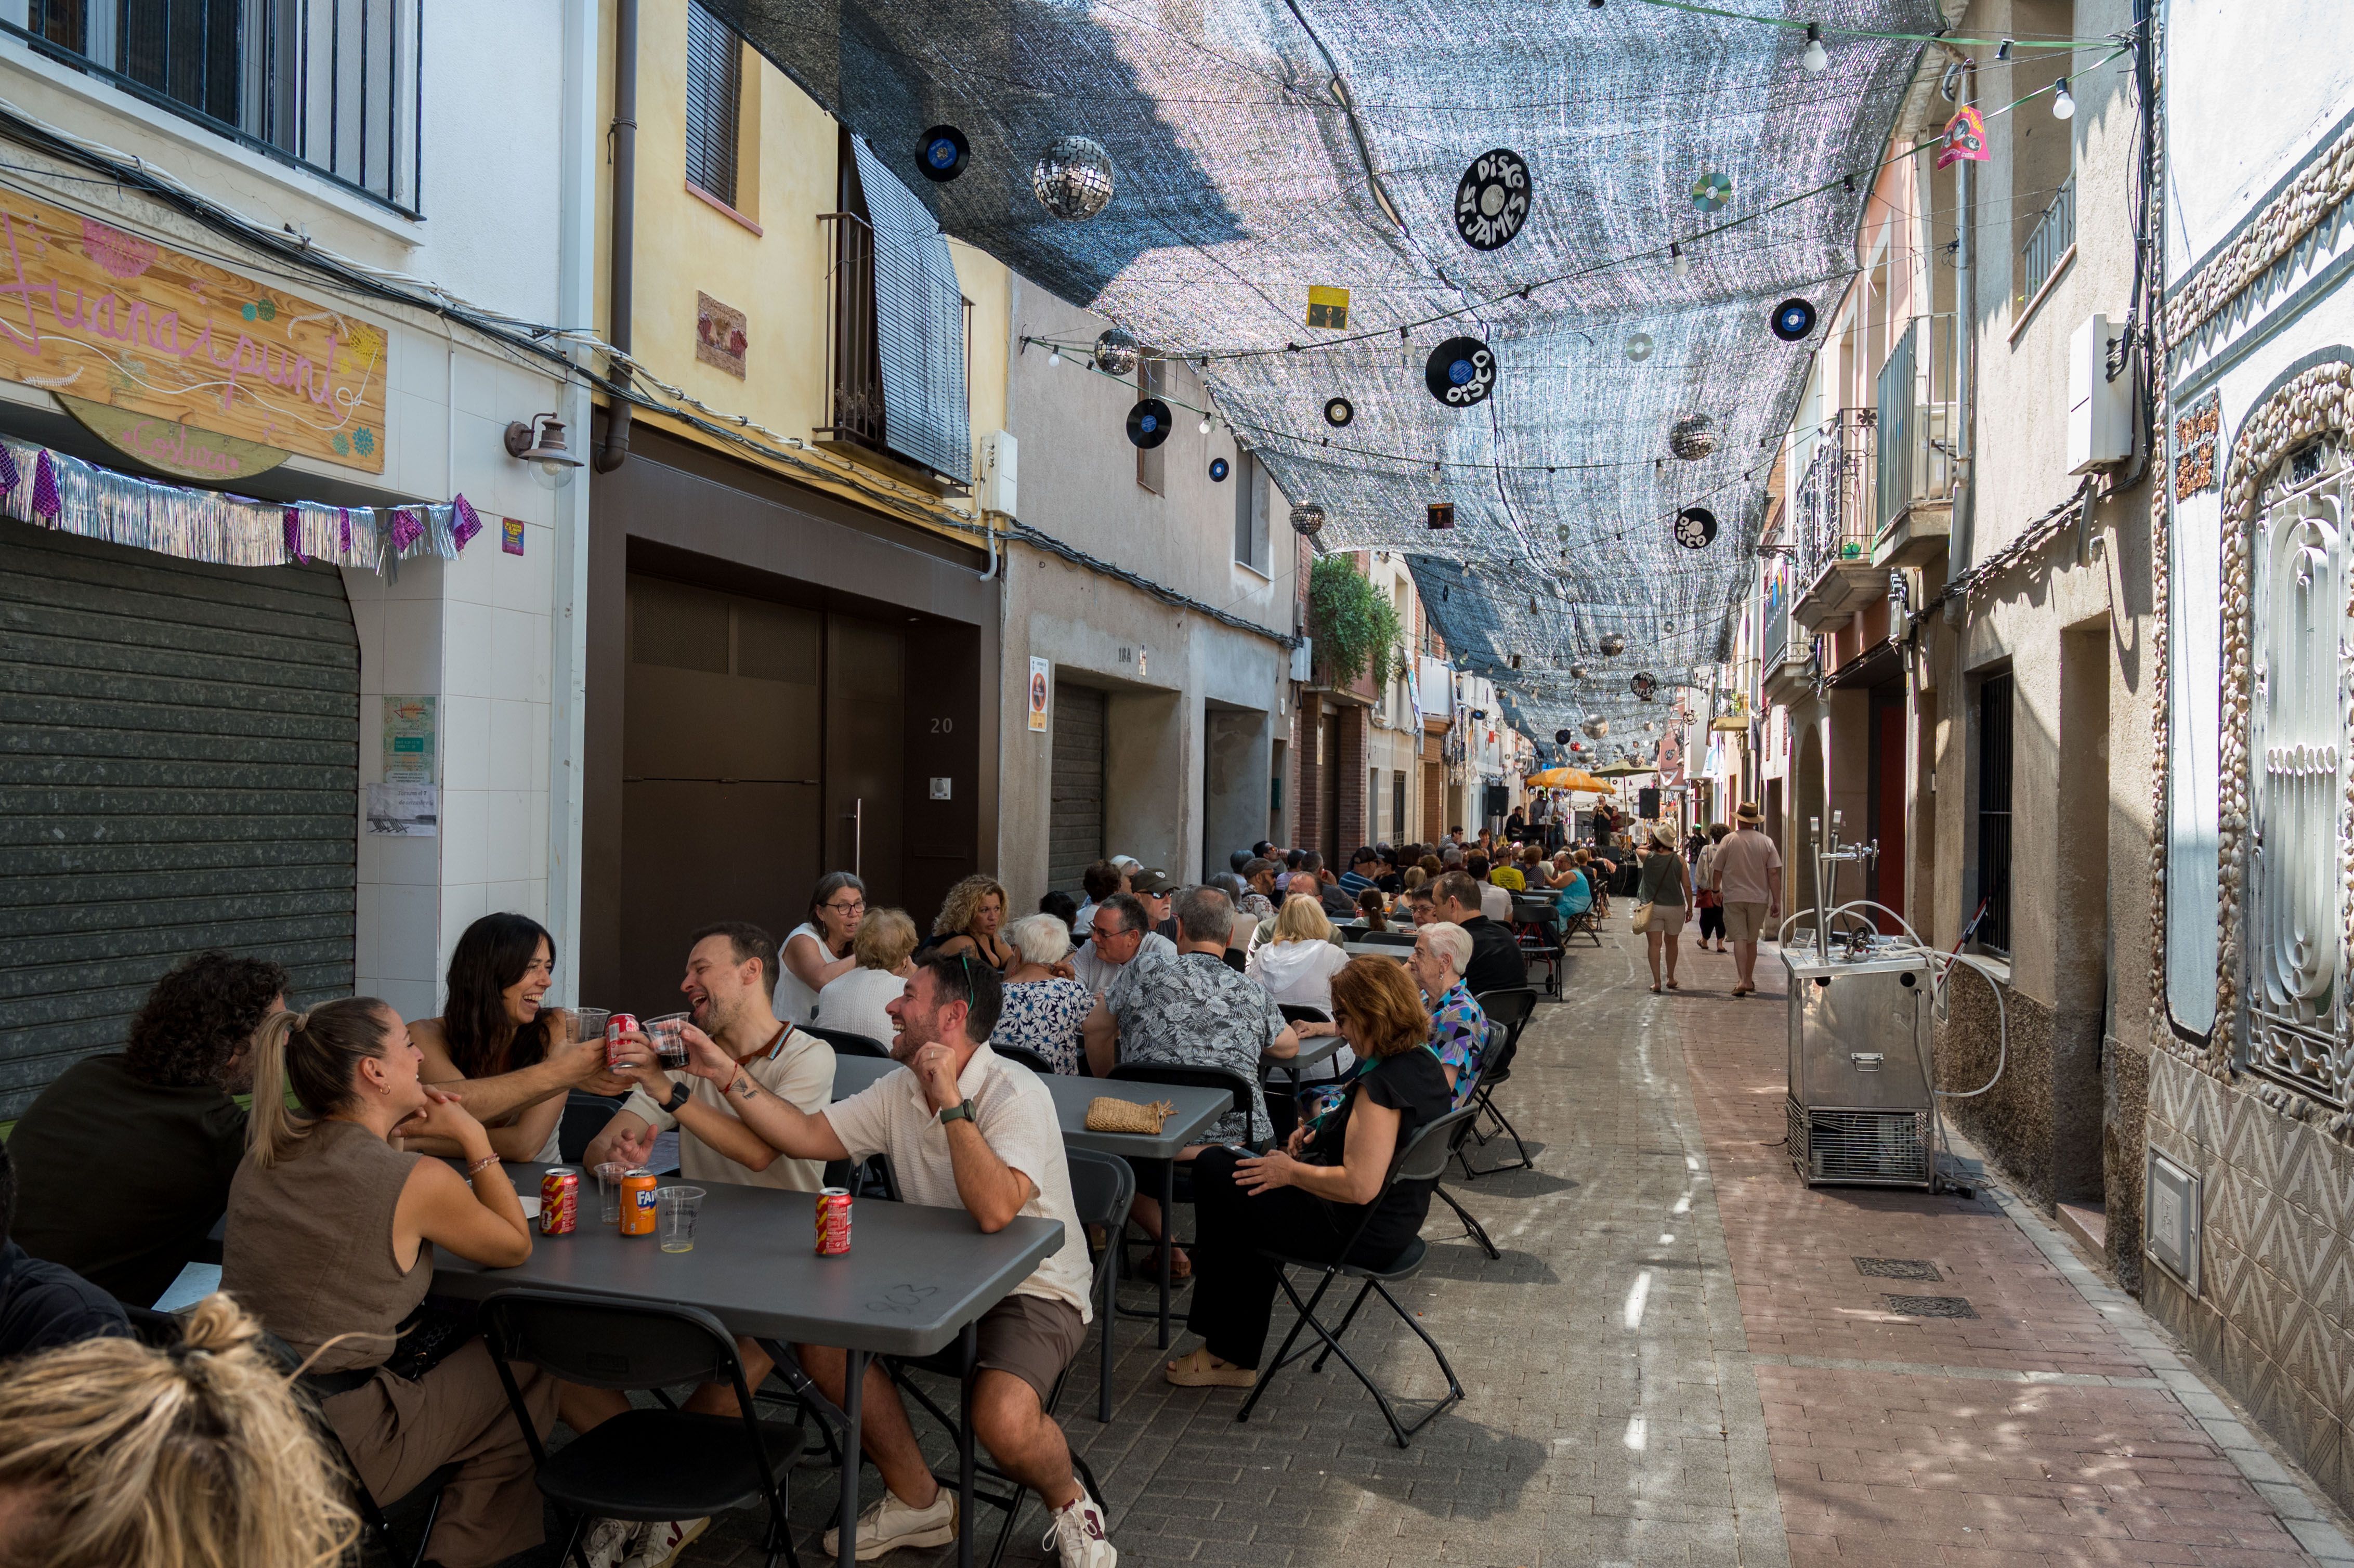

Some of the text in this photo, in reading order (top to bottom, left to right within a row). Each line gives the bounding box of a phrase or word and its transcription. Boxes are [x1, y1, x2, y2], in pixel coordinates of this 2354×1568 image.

[1465, 192, 1526, 245] JAMES
[134, 422, 230, 474] Costura
[1638, 673, 1654, 684] THE
[1631, 680, 1655, 697] BEATLES
[931, 718, 952, 734] 20
